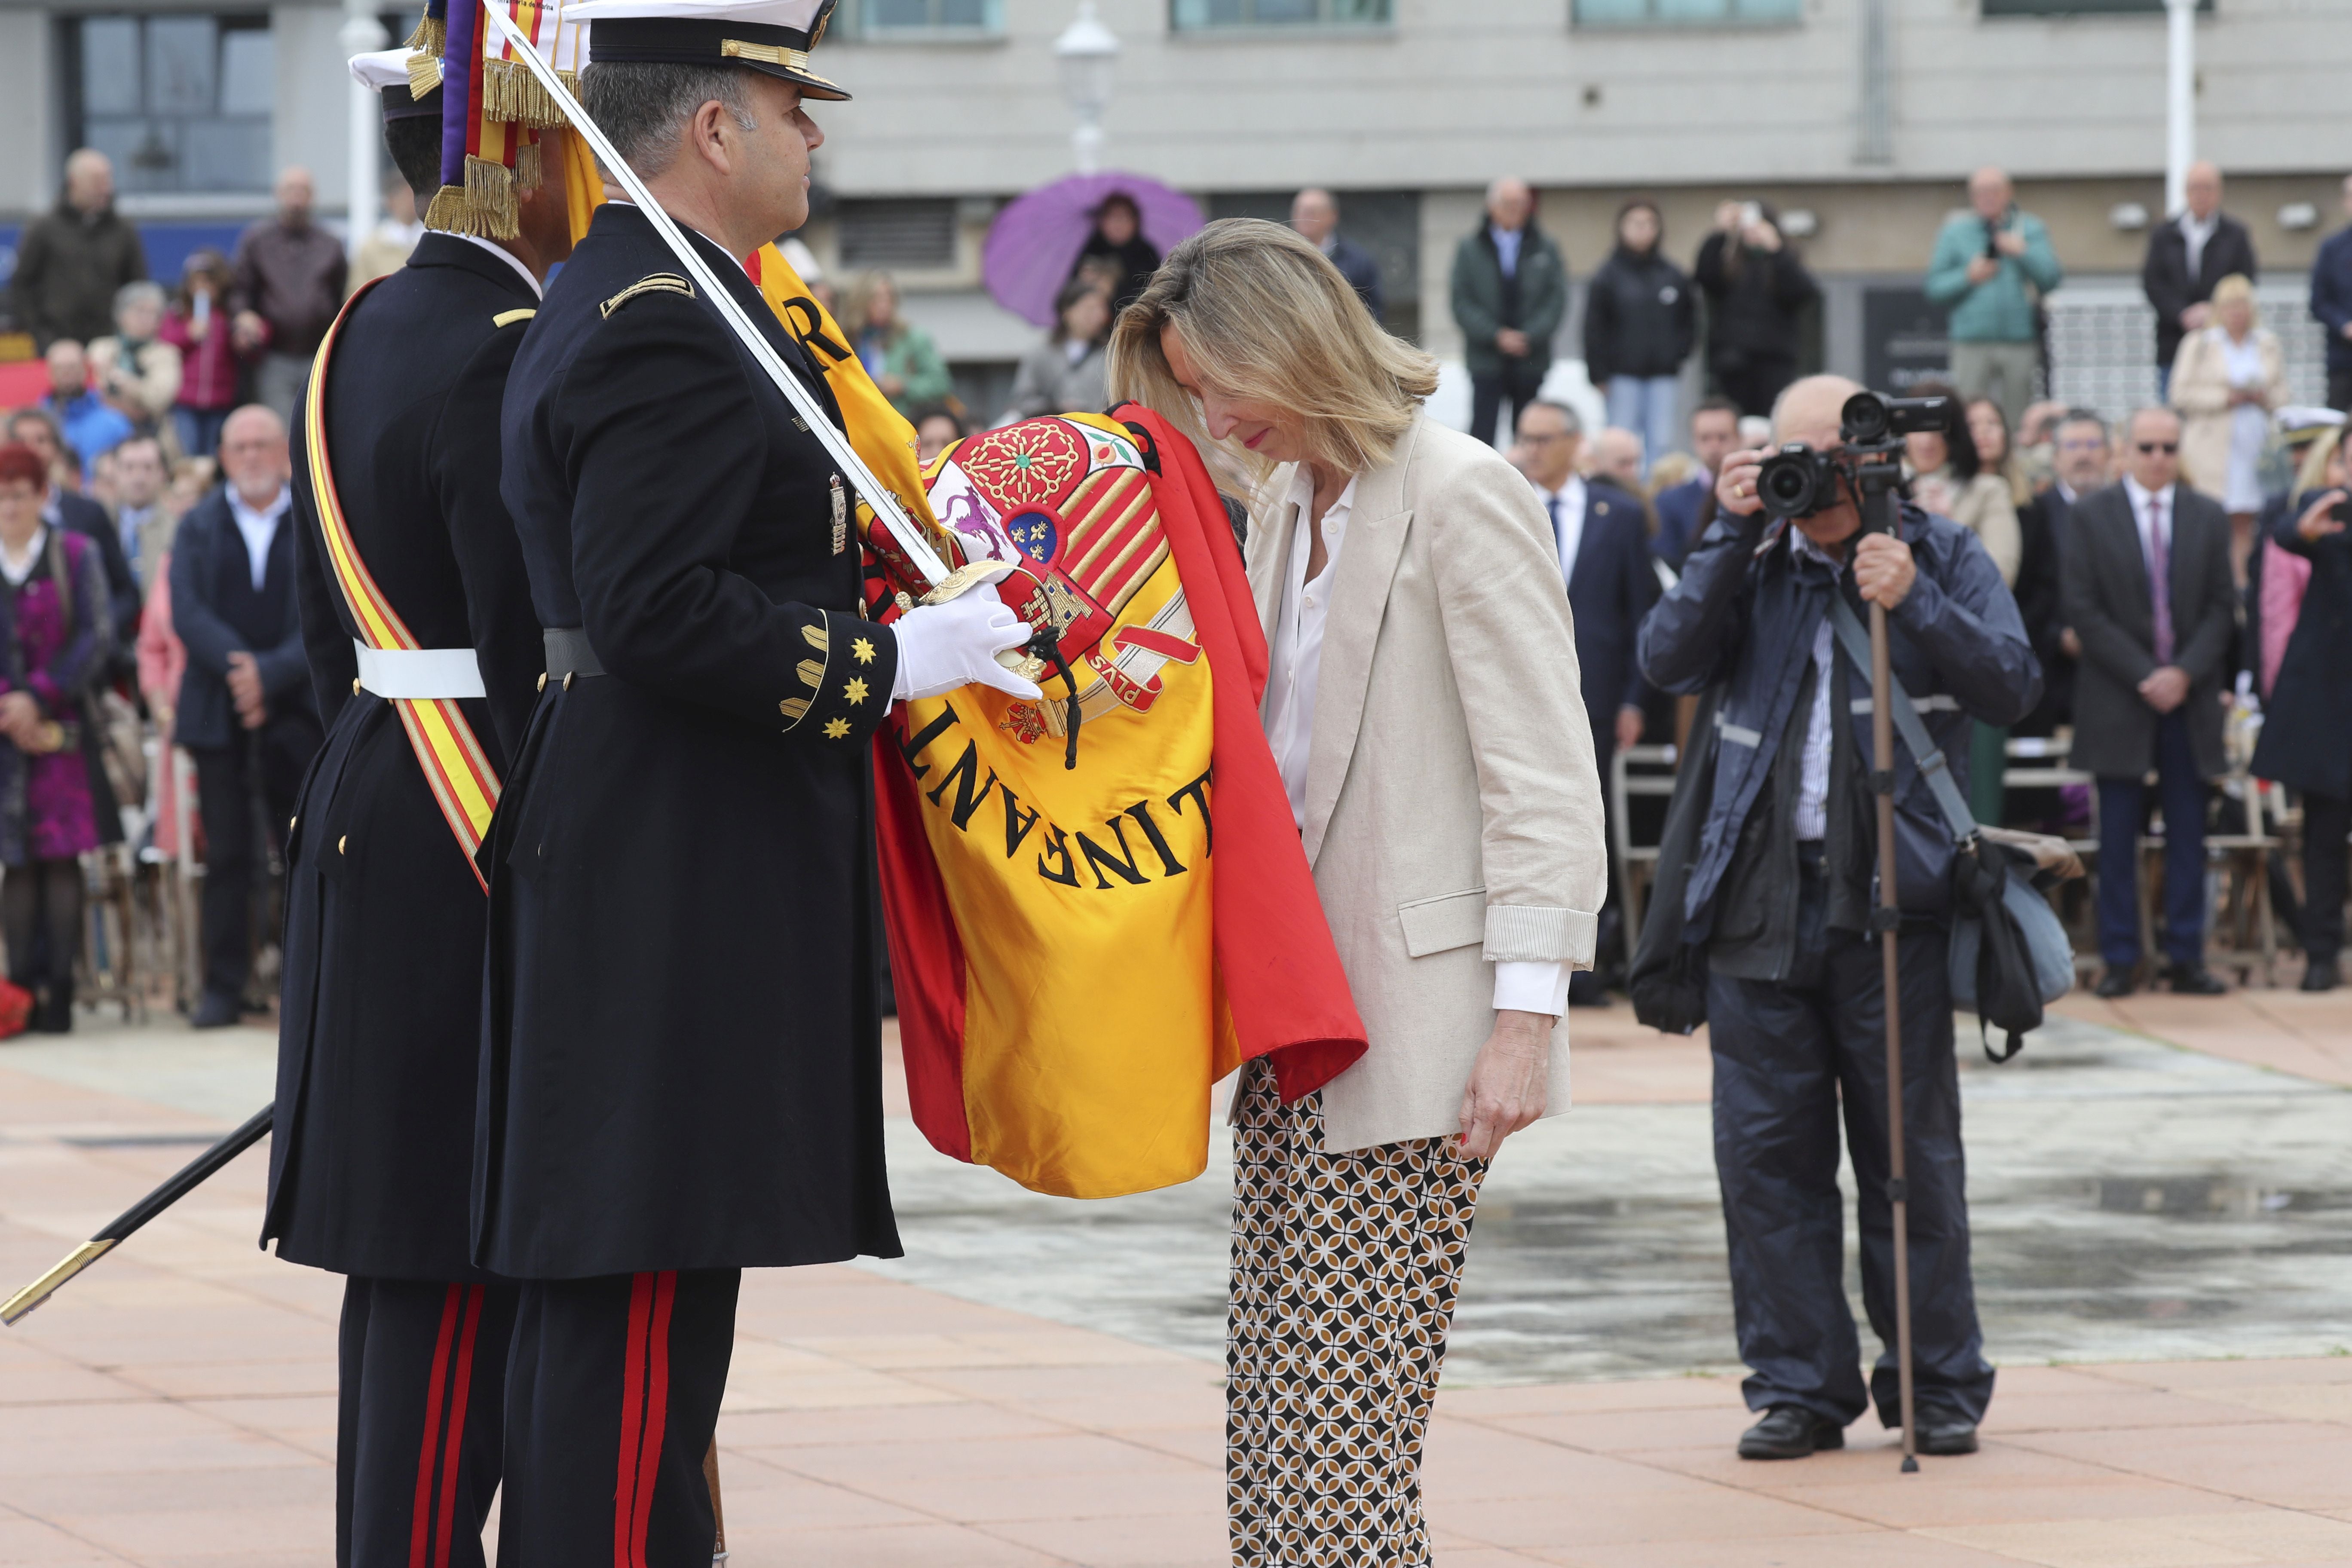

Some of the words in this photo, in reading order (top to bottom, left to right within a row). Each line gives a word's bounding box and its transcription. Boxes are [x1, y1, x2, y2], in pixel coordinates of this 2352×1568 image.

[536, 2, 553, 10] Marina
[782, 297, 851, 372] R
[1089, 655, 1141, 704] PLVS
